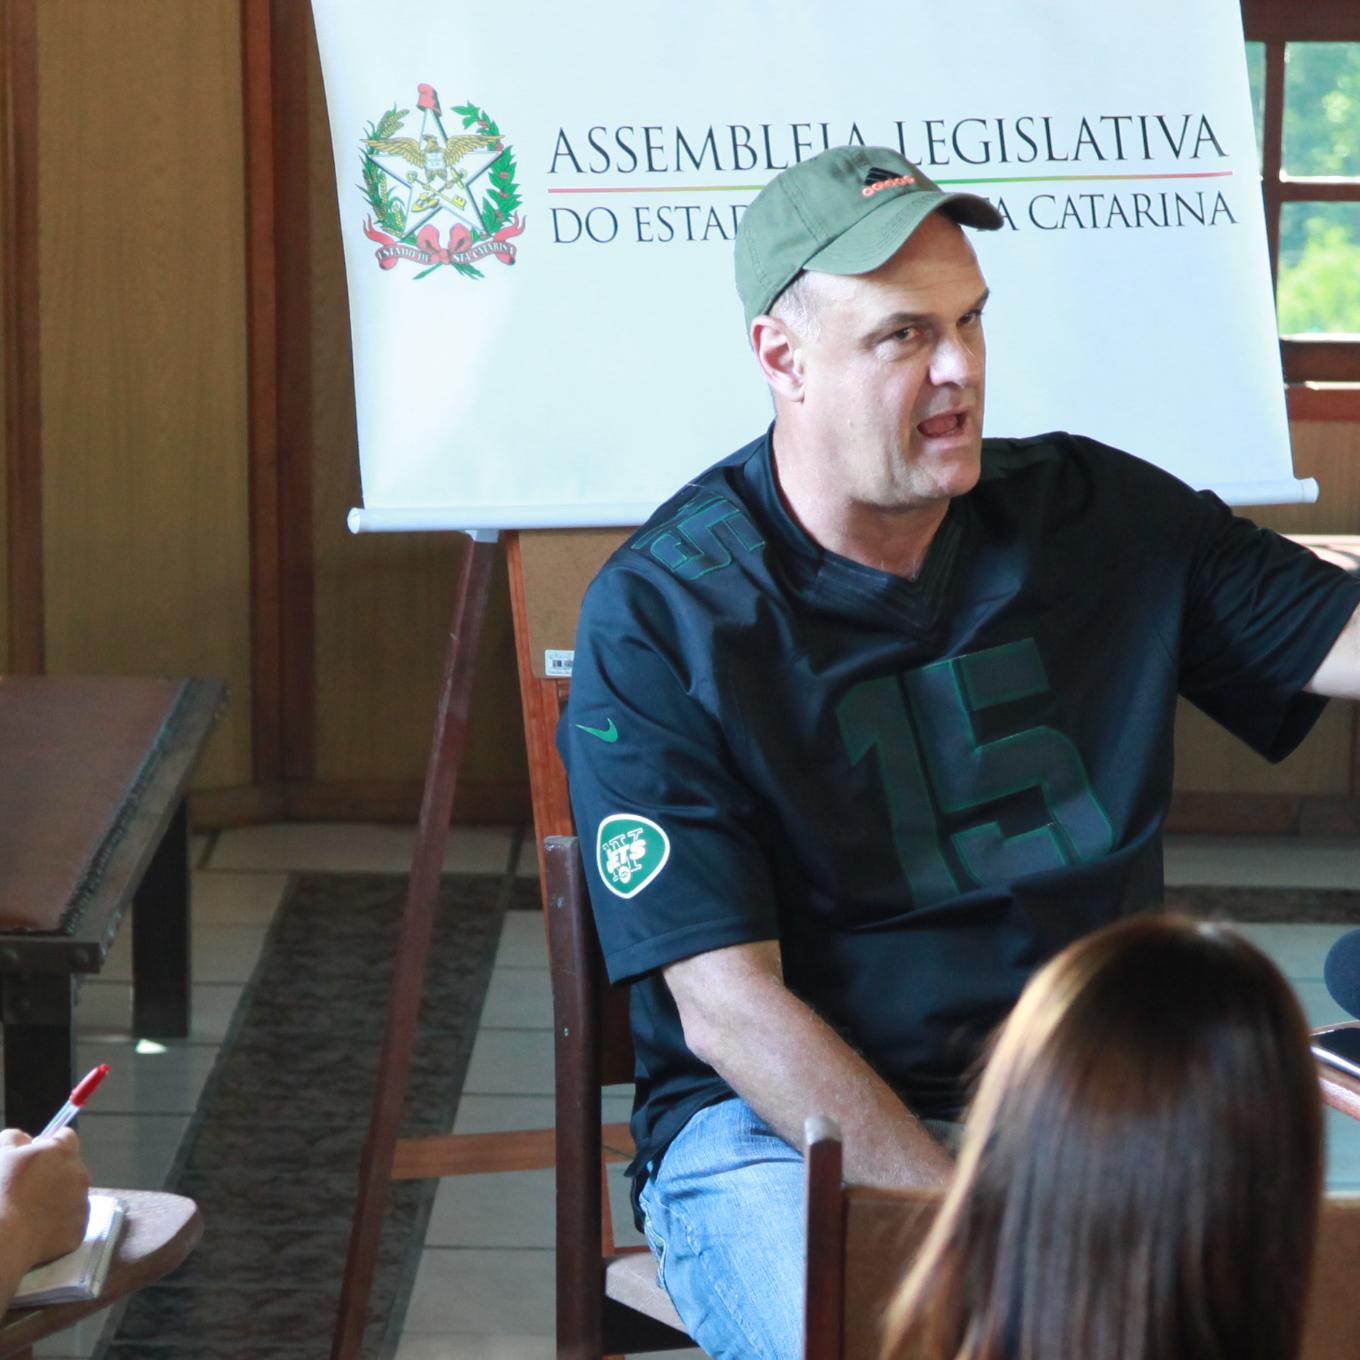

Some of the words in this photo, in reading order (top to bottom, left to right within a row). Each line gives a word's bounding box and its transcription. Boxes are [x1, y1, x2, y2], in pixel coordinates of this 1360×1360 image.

[892, 113, 1230, 166] LEGISLATIVA
[549, 206, 619, 244] DO
[1028, 190, 1240, 230] CATARINA
[834, 636, 1115, 912] 15
[605, 838, 647, 874] JETS
